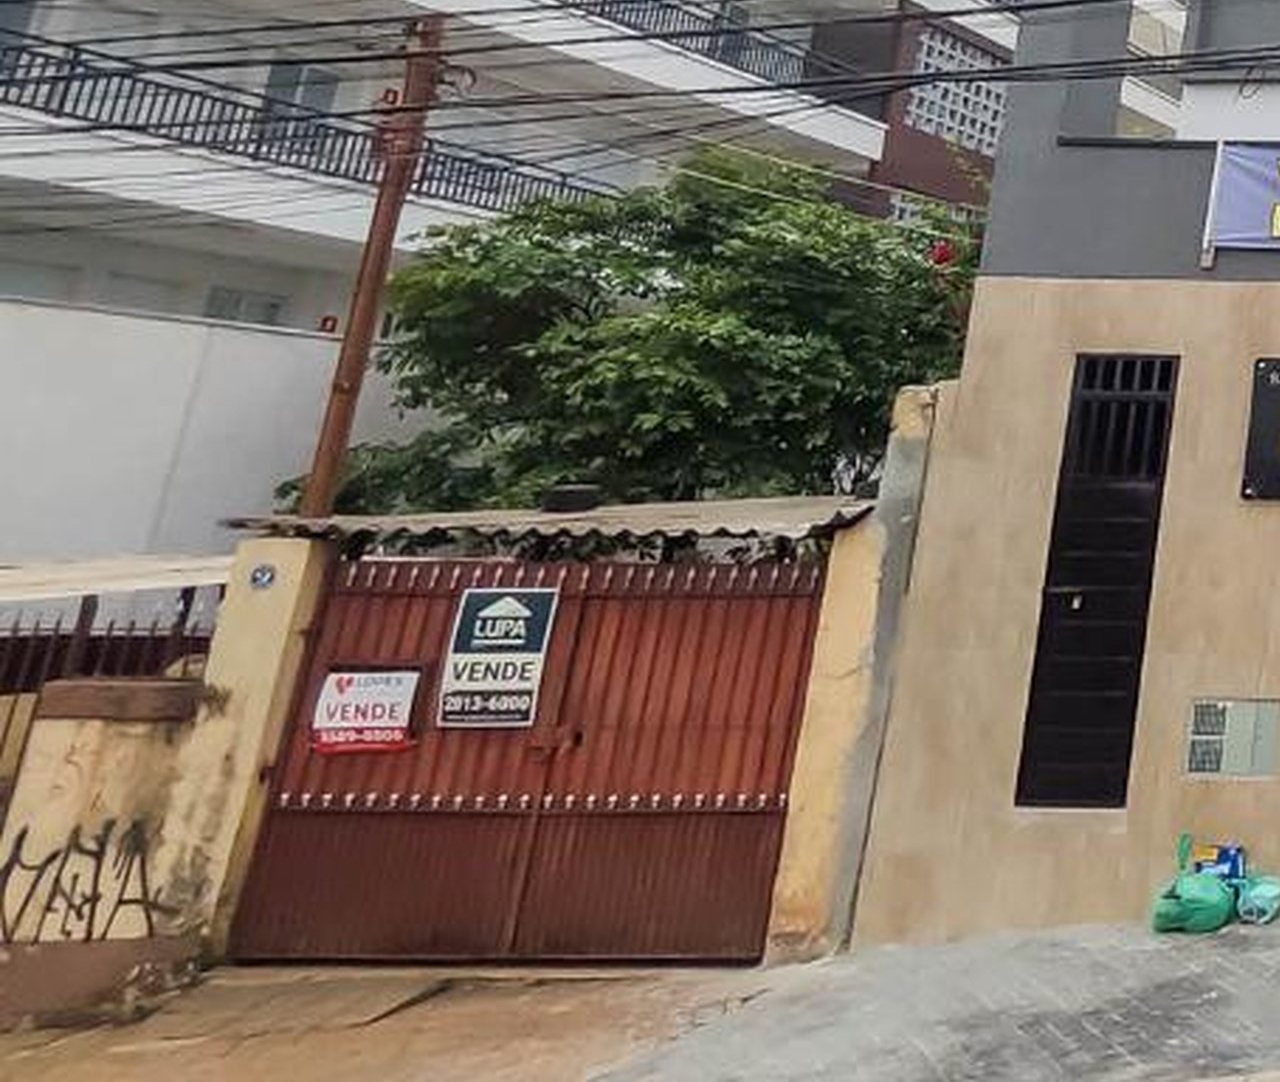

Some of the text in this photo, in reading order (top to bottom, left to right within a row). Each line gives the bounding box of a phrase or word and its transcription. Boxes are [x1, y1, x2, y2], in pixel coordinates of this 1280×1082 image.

[474, 619, 526, 638] LUPA
[453, 661, 535, 682] VENDE
[326, 702, 401, 721] VENDE
